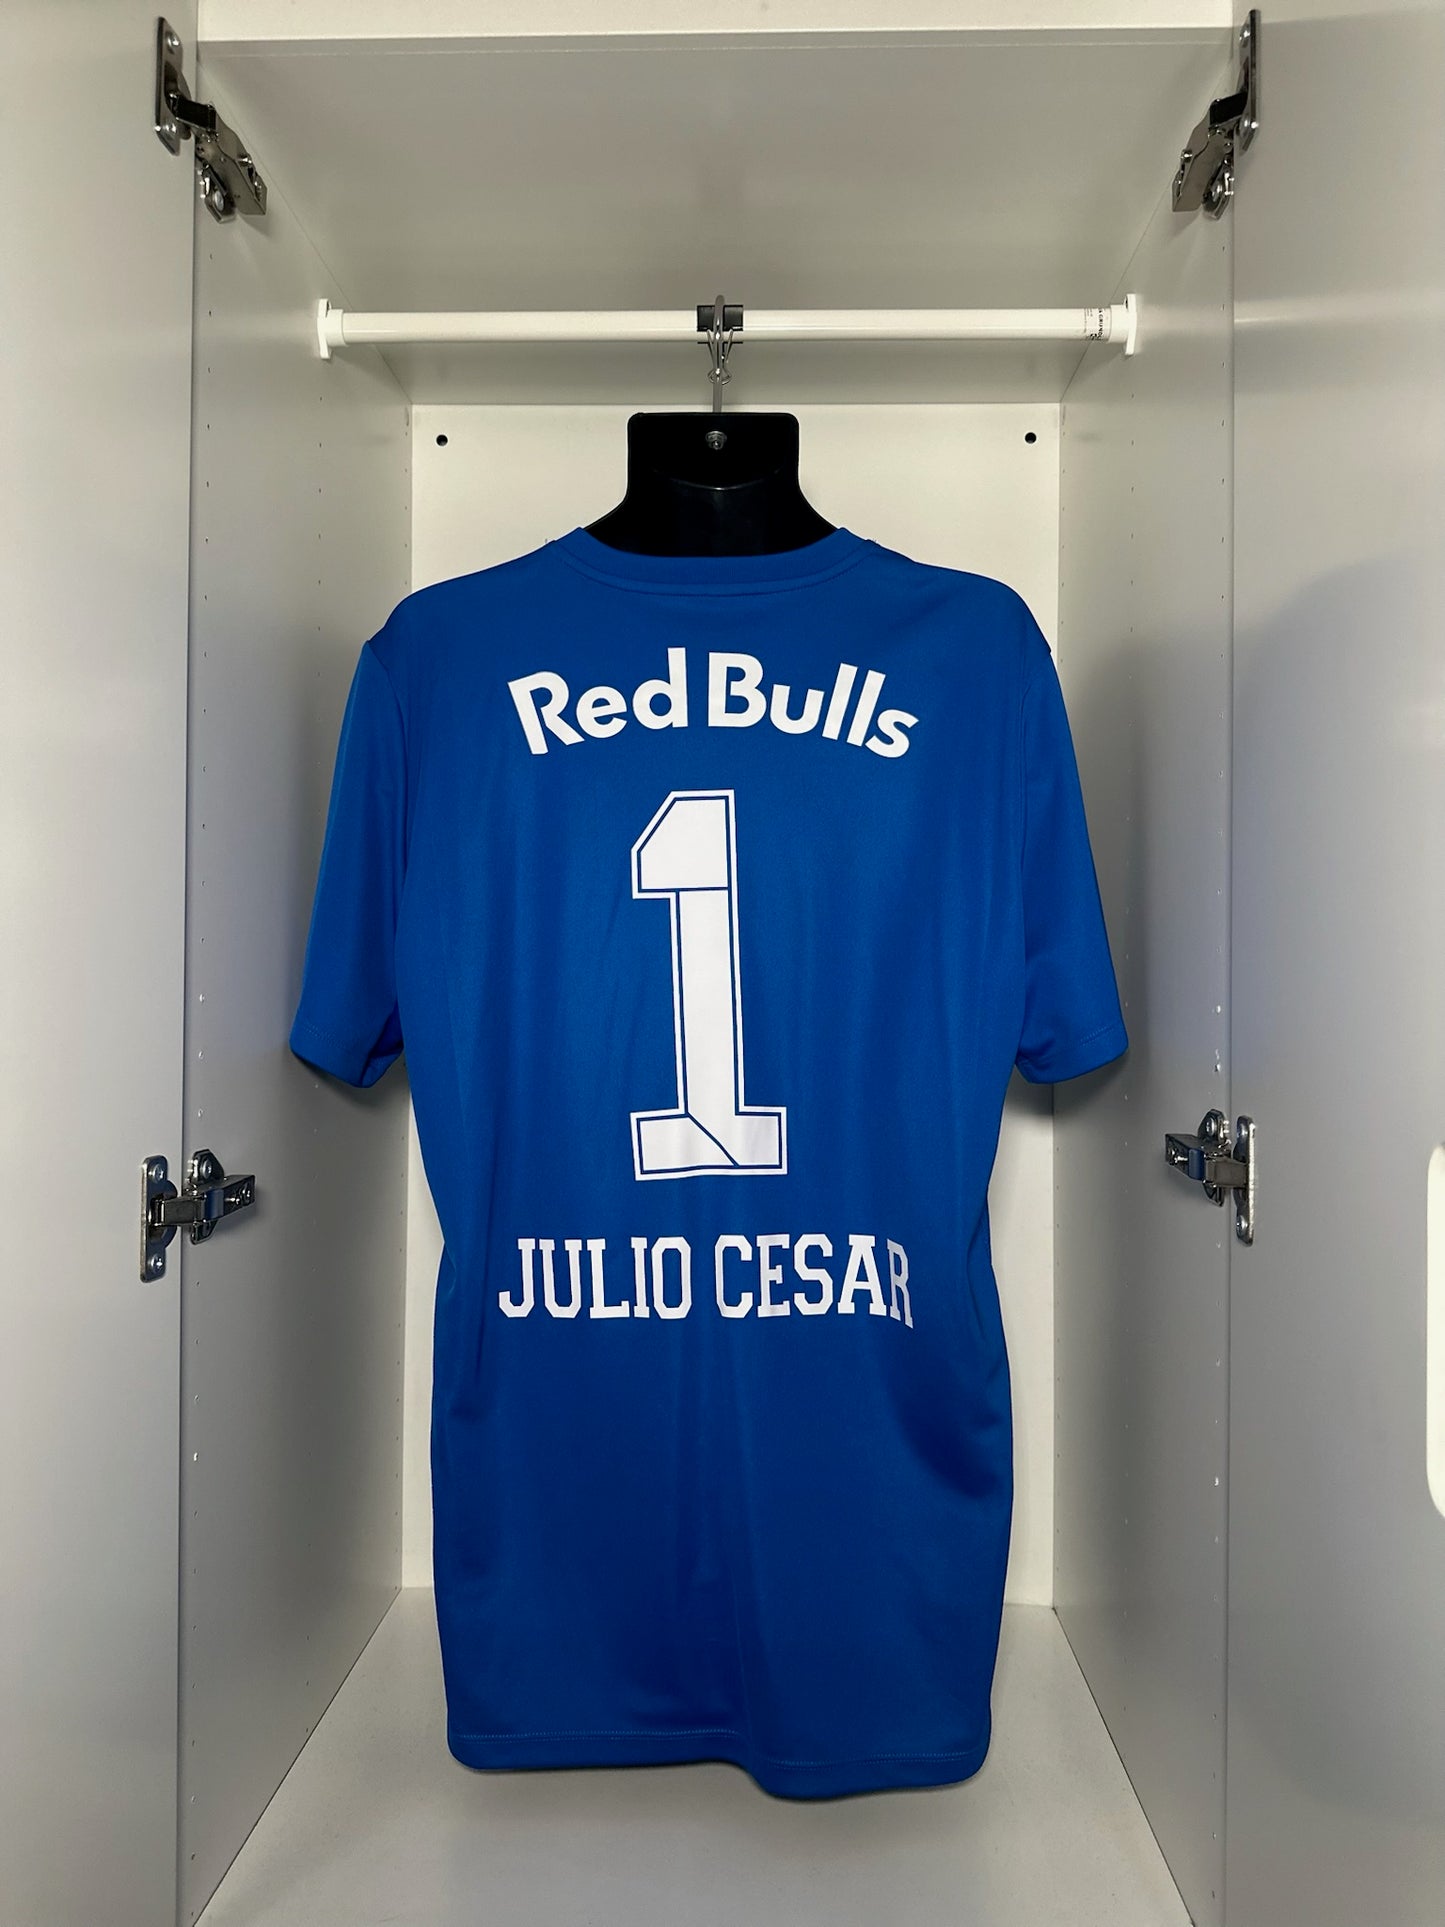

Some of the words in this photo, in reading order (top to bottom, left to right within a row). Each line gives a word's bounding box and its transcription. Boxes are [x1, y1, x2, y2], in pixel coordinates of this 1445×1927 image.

[508, 648, 689, 754] Red
[708, 652, 919, 757] Bulls
[630, 790, 787, 1180] 1
[498, 1237, 692, 1319] JULIO
[714, 1233, 914, 1329] CESAR
